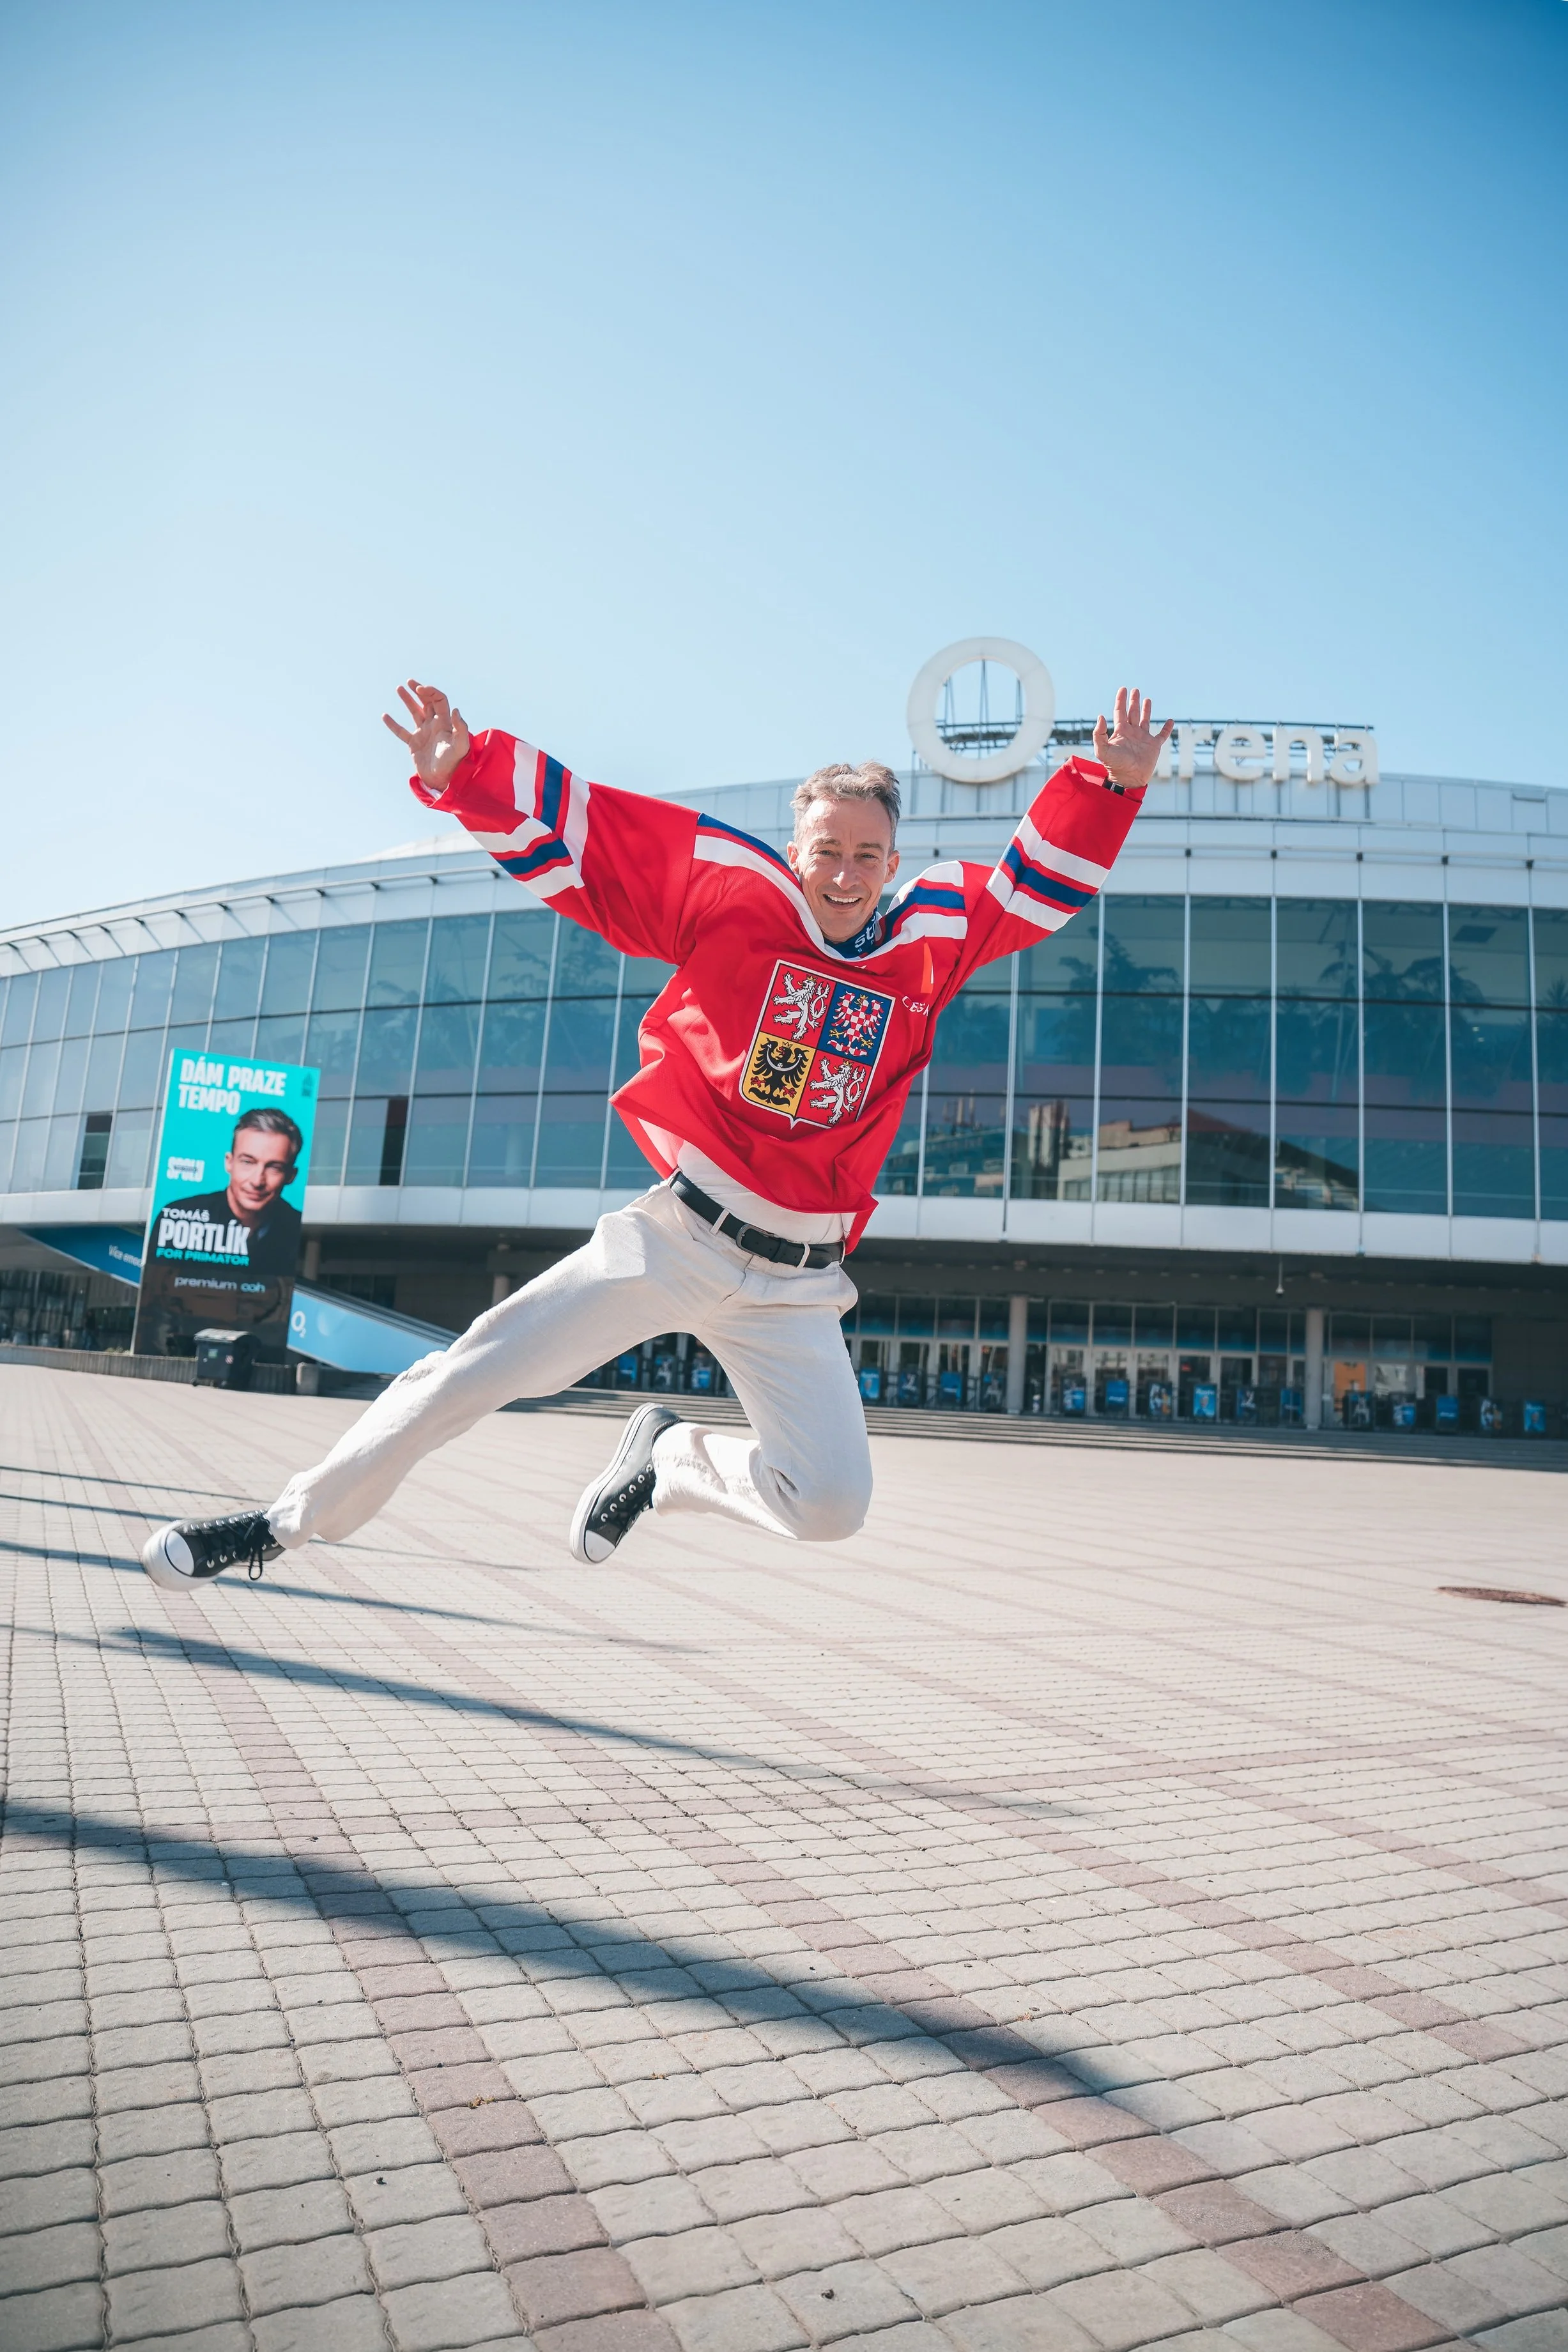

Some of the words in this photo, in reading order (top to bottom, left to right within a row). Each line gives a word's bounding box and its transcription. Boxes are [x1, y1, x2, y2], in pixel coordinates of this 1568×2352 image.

[180, 1056, 224, 1088] DÁM
[227, 1065, 287, 1096] PRAZE
[178, 1083, 242, 1115] TEMPO
[161, 1208, 210, 1222] TOMÁŠ
[158, 1217, 250, 1256] PORTLÍK
[156, 1247, 183, 1260] FOR
[184, 1250, 250, 1266] PRIMATOR
[174, 1277, 237, 1291] premium
